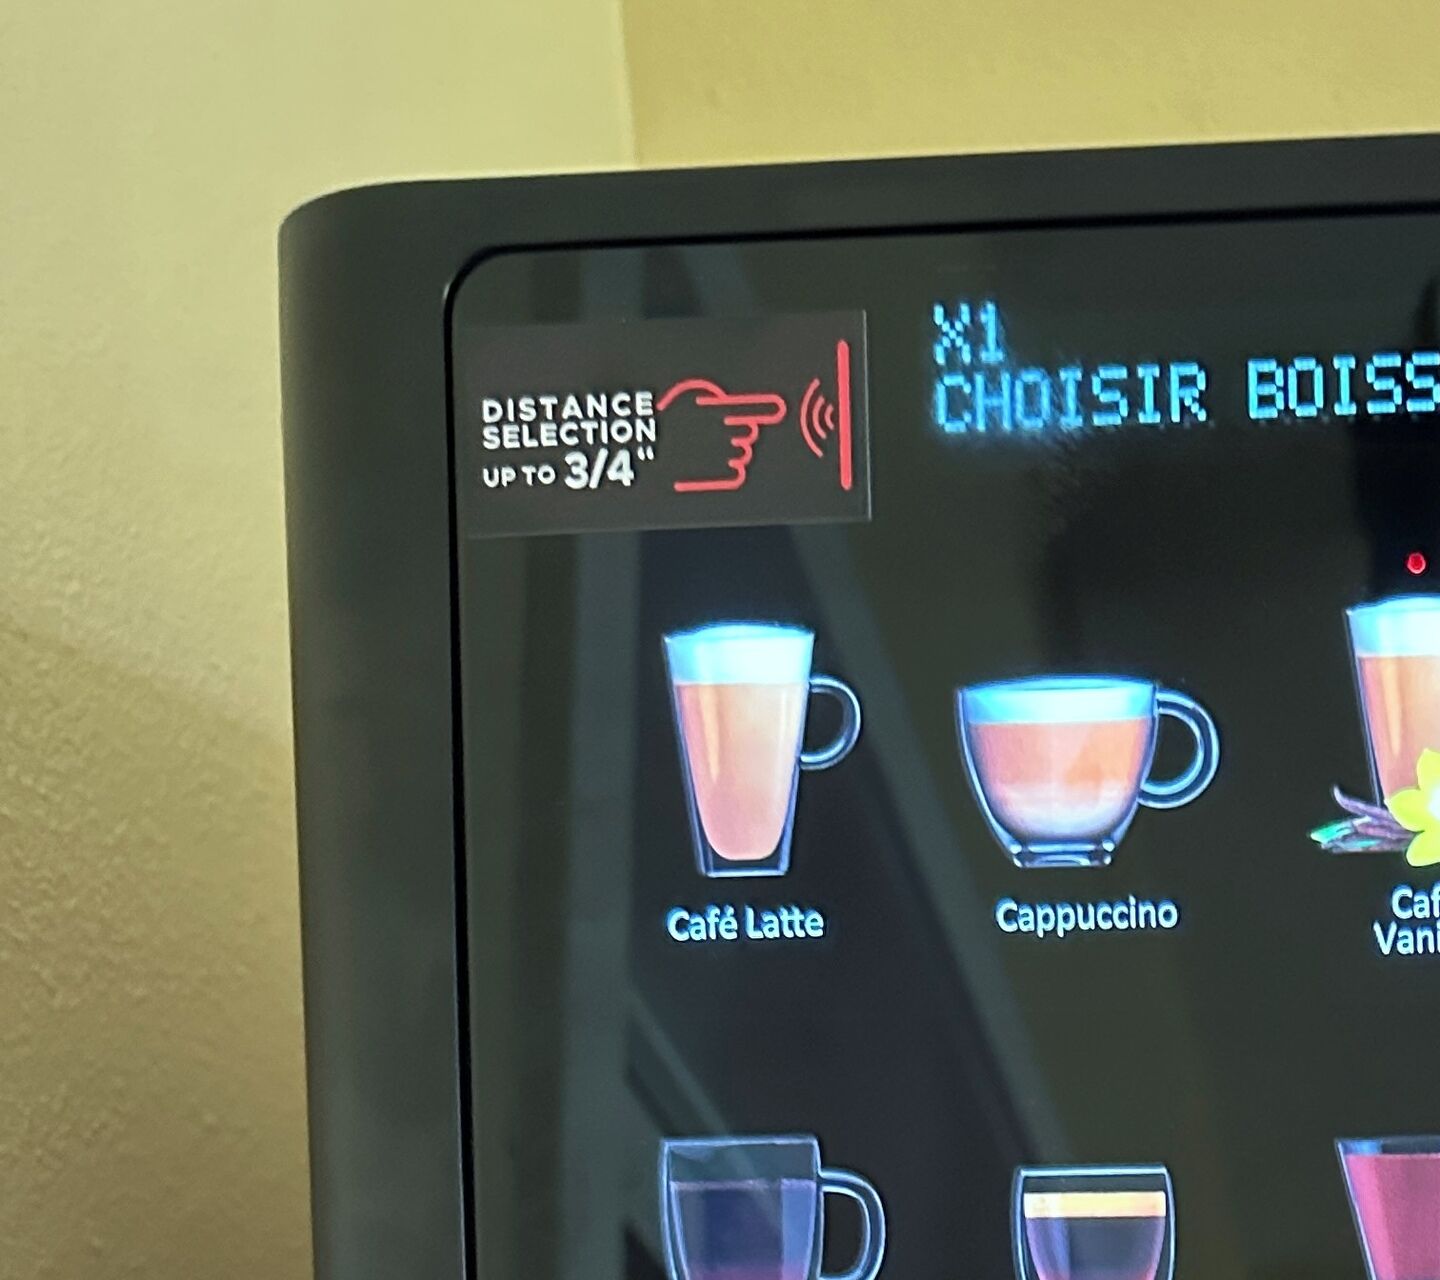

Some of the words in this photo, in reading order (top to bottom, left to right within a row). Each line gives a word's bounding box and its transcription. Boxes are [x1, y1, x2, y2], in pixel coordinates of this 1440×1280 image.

[933, 301, 1004, 365] X1
[482, 391, 653, 423] DISTANCE
[935, 361, 1208, 433] CHOISIR
[482, 418, 656, 449] SELECTION
[482, 465, 516, 488] UP
[520, 463, 556, 487] TO
[668, 905, 738, 942] Café
[743, 904, 825, 940] Latte
[996, 896, 1180, 937] Cappuccino
